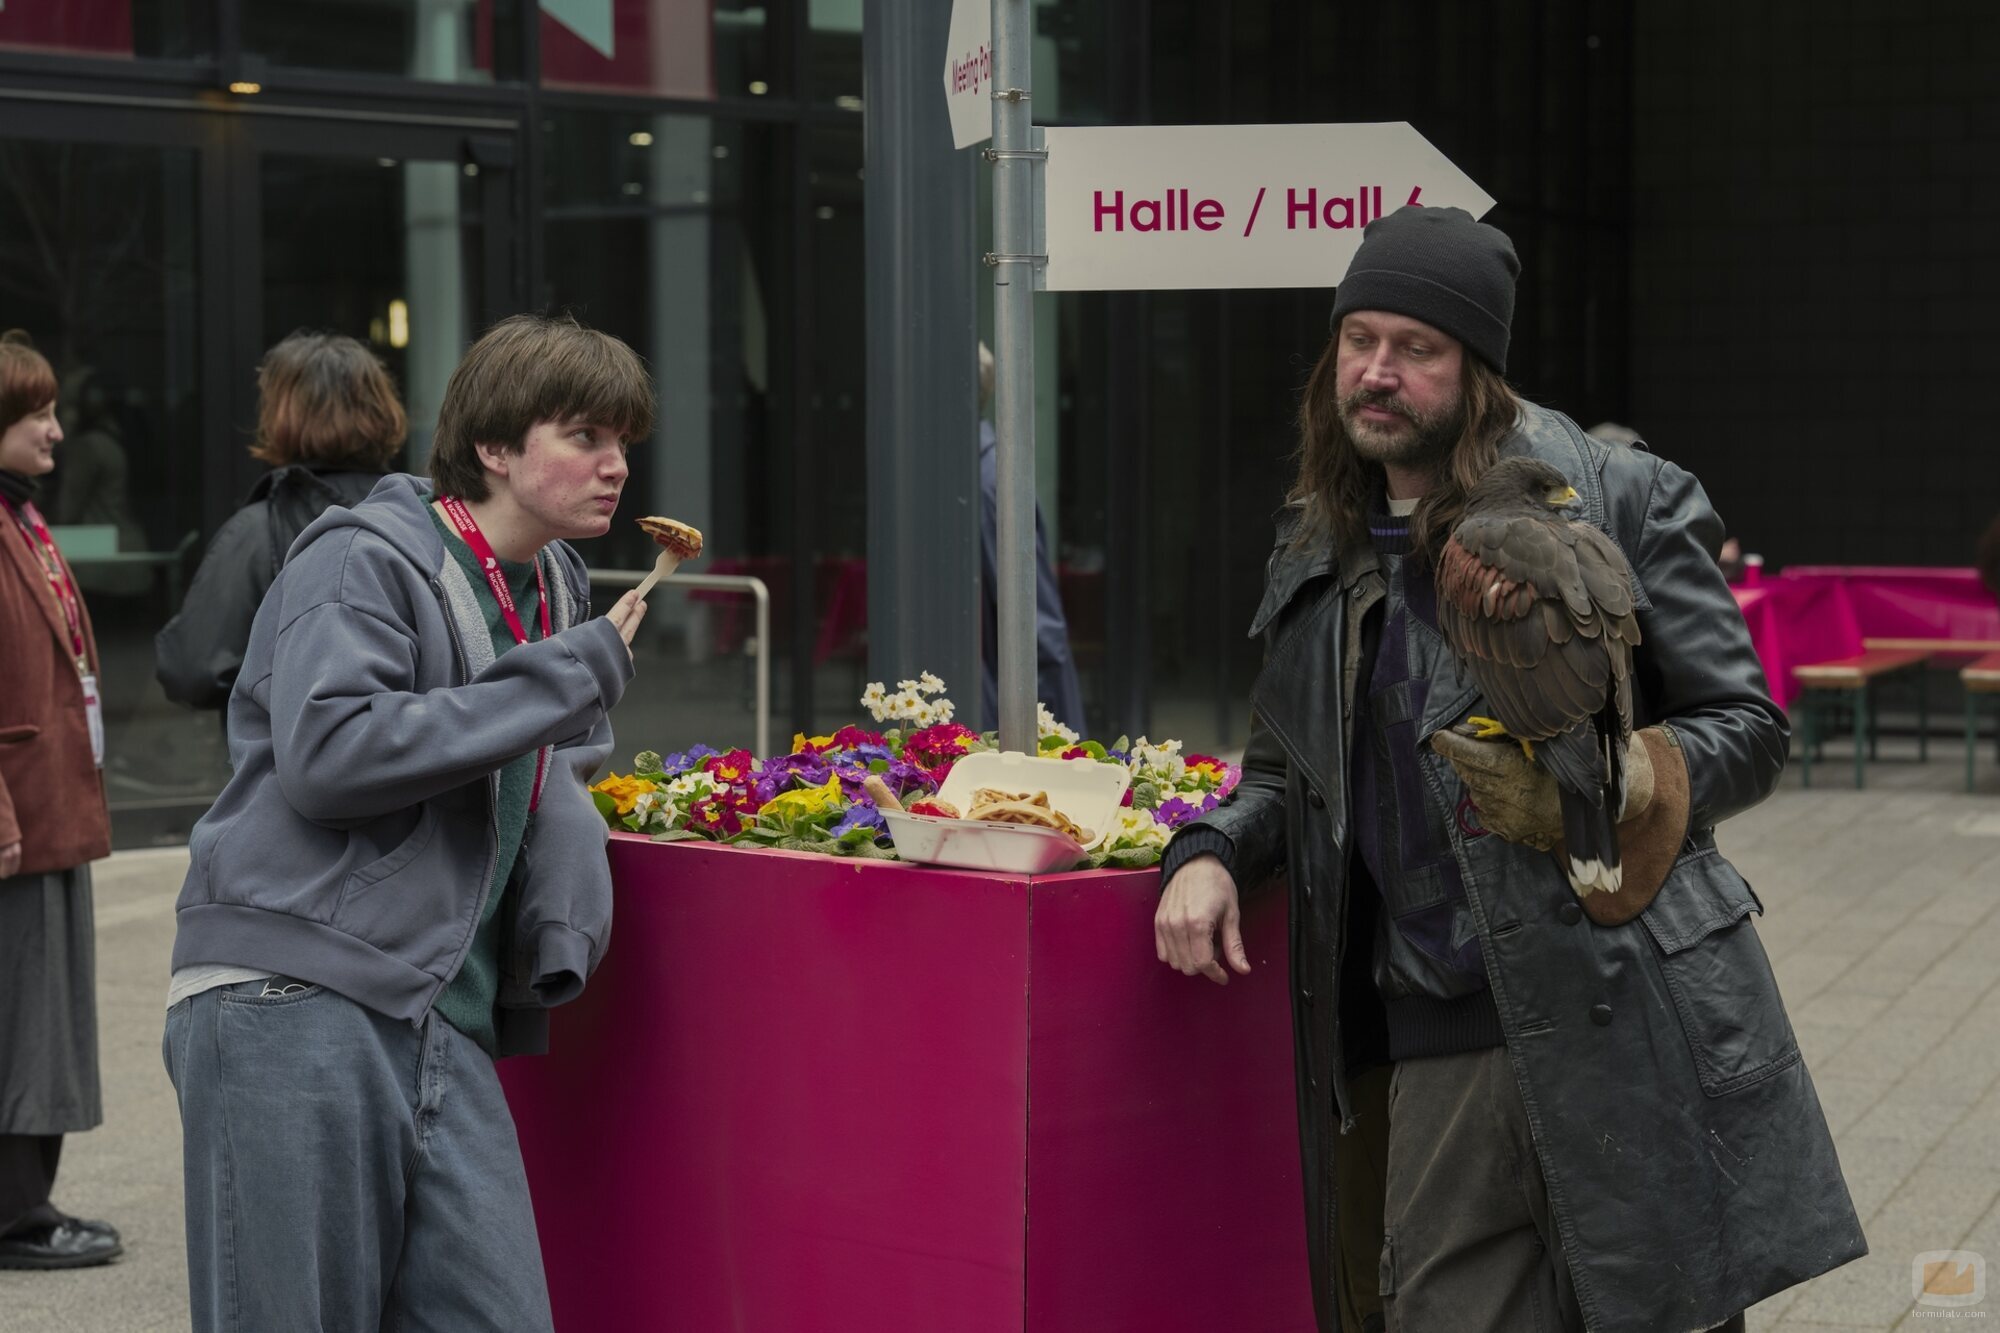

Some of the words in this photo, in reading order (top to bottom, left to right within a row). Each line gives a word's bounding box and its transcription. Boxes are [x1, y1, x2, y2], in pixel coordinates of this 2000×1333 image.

[951, 51, 979, 96] Meeting
[1094, 188, 1225, 232] Halle
[1243, 187, 1266, 237] /
[1287, 186, 1381, 229] Hall
[489, 572, 508, 609] BUCHMESSE
[495, 569, 515, 613] FRANKFURTER
